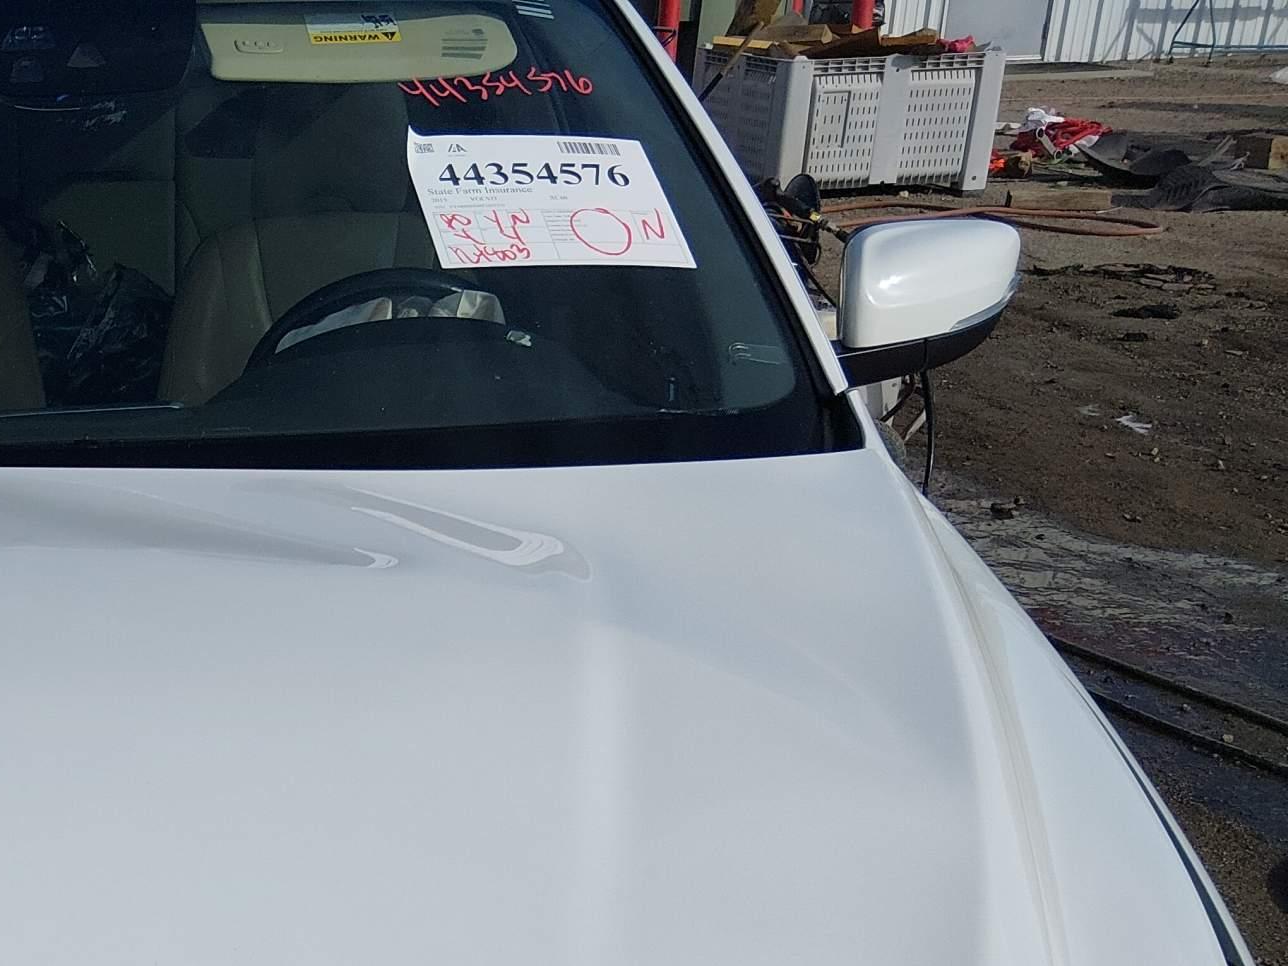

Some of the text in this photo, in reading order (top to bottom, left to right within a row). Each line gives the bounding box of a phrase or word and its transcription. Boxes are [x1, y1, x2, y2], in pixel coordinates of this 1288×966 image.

[314, 34, 380, 43] WARNING
[398, 67, 593, 107] 44354576
[439, 162, 630, 187] 44354576
[427, 186, 534, 196] State Farm Insurance
